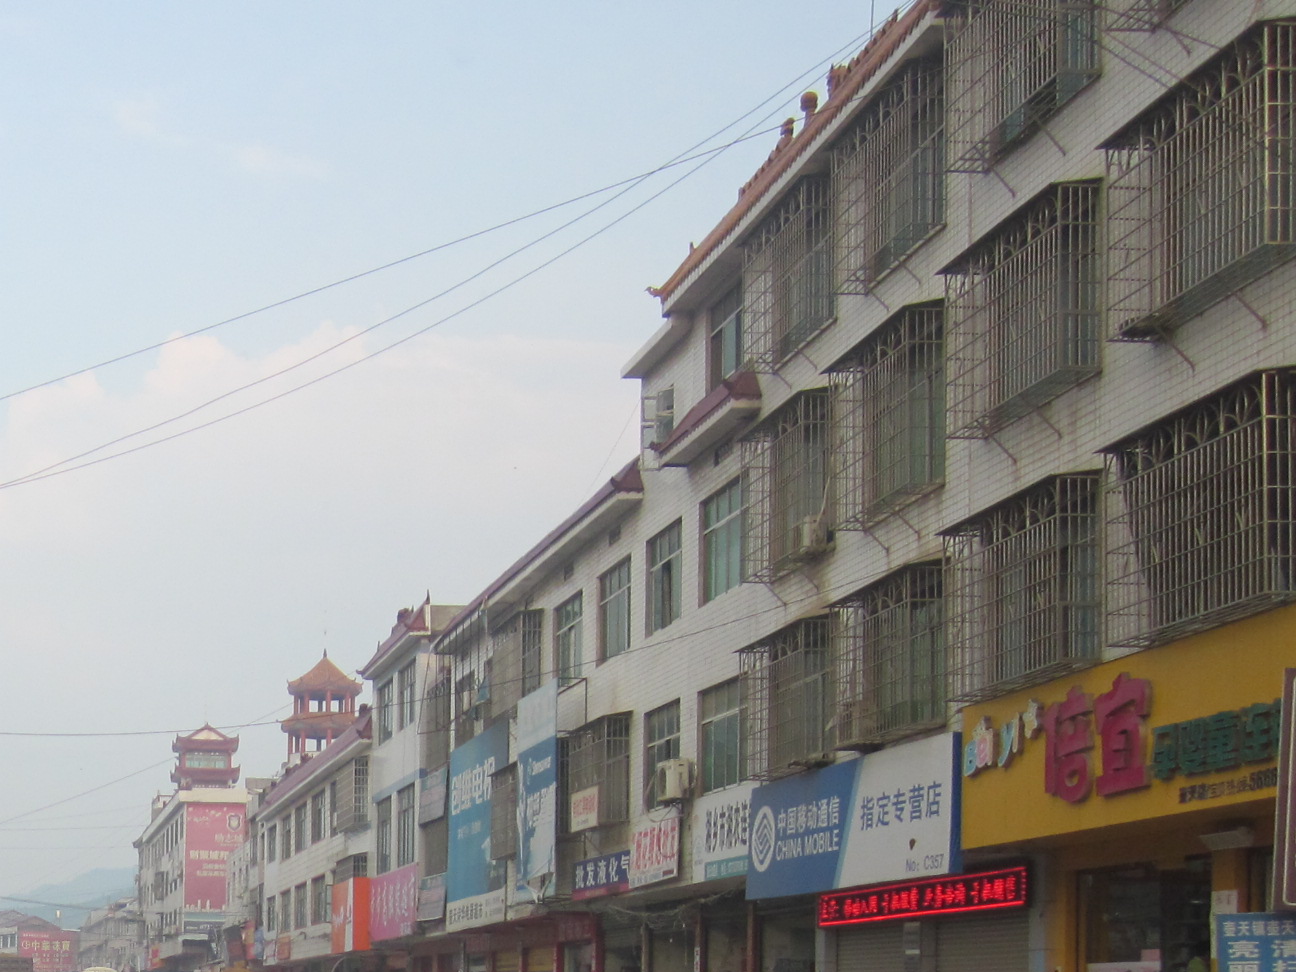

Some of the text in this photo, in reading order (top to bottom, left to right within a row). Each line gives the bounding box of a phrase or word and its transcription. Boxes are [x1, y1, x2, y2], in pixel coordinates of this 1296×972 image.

[777, 795, 840, 836] 中国移动通信
[860, 781, 942, 831] 指定专营店
[775, 829, 840, 861] CHINA MOBILE
[923, 853, 944, 871] C357
